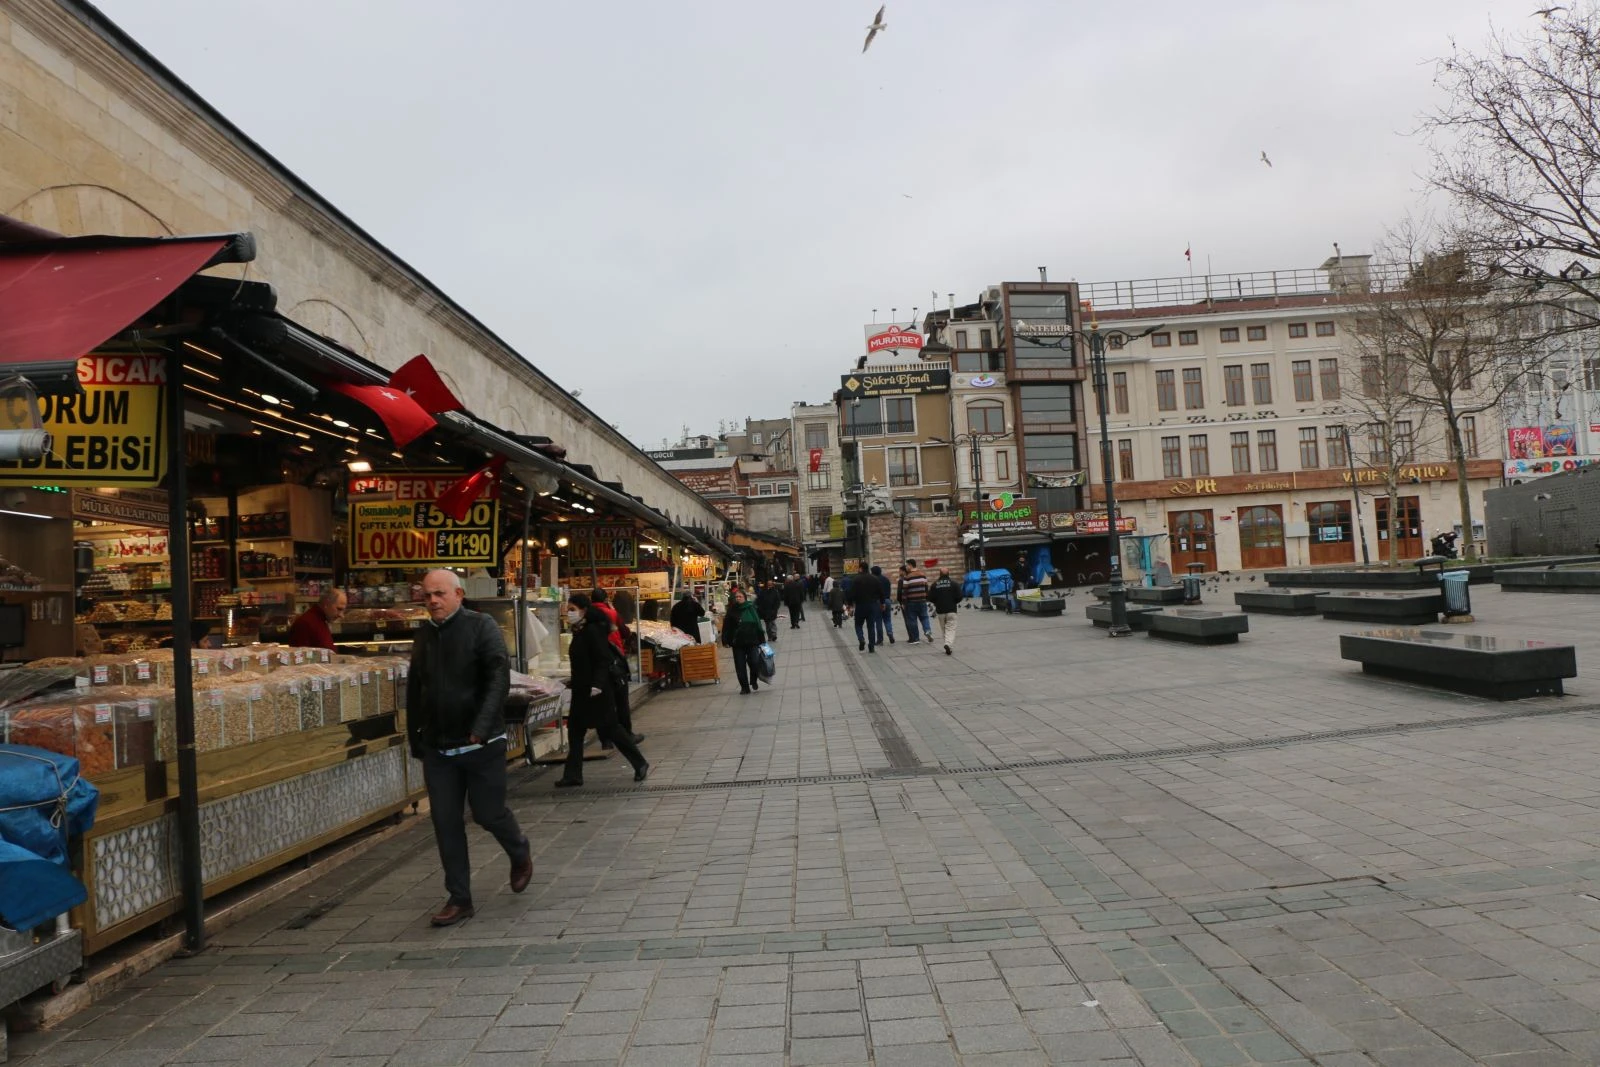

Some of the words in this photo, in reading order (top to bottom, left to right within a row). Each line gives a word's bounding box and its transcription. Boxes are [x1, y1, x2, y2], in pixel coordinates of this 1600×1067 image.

[870, 335, 920, 348] MURATBEY
[77, 358, 167, 384] SICAK
[1513, 430, 1538, 441] Barbie
[653, 451, 674, 459] GÜÇLÜ
[1195, 479, 1217, 493] Ptt
[81, 498, 111, 514] MÜLK
[358, 531, 435, 559] LOKUM
